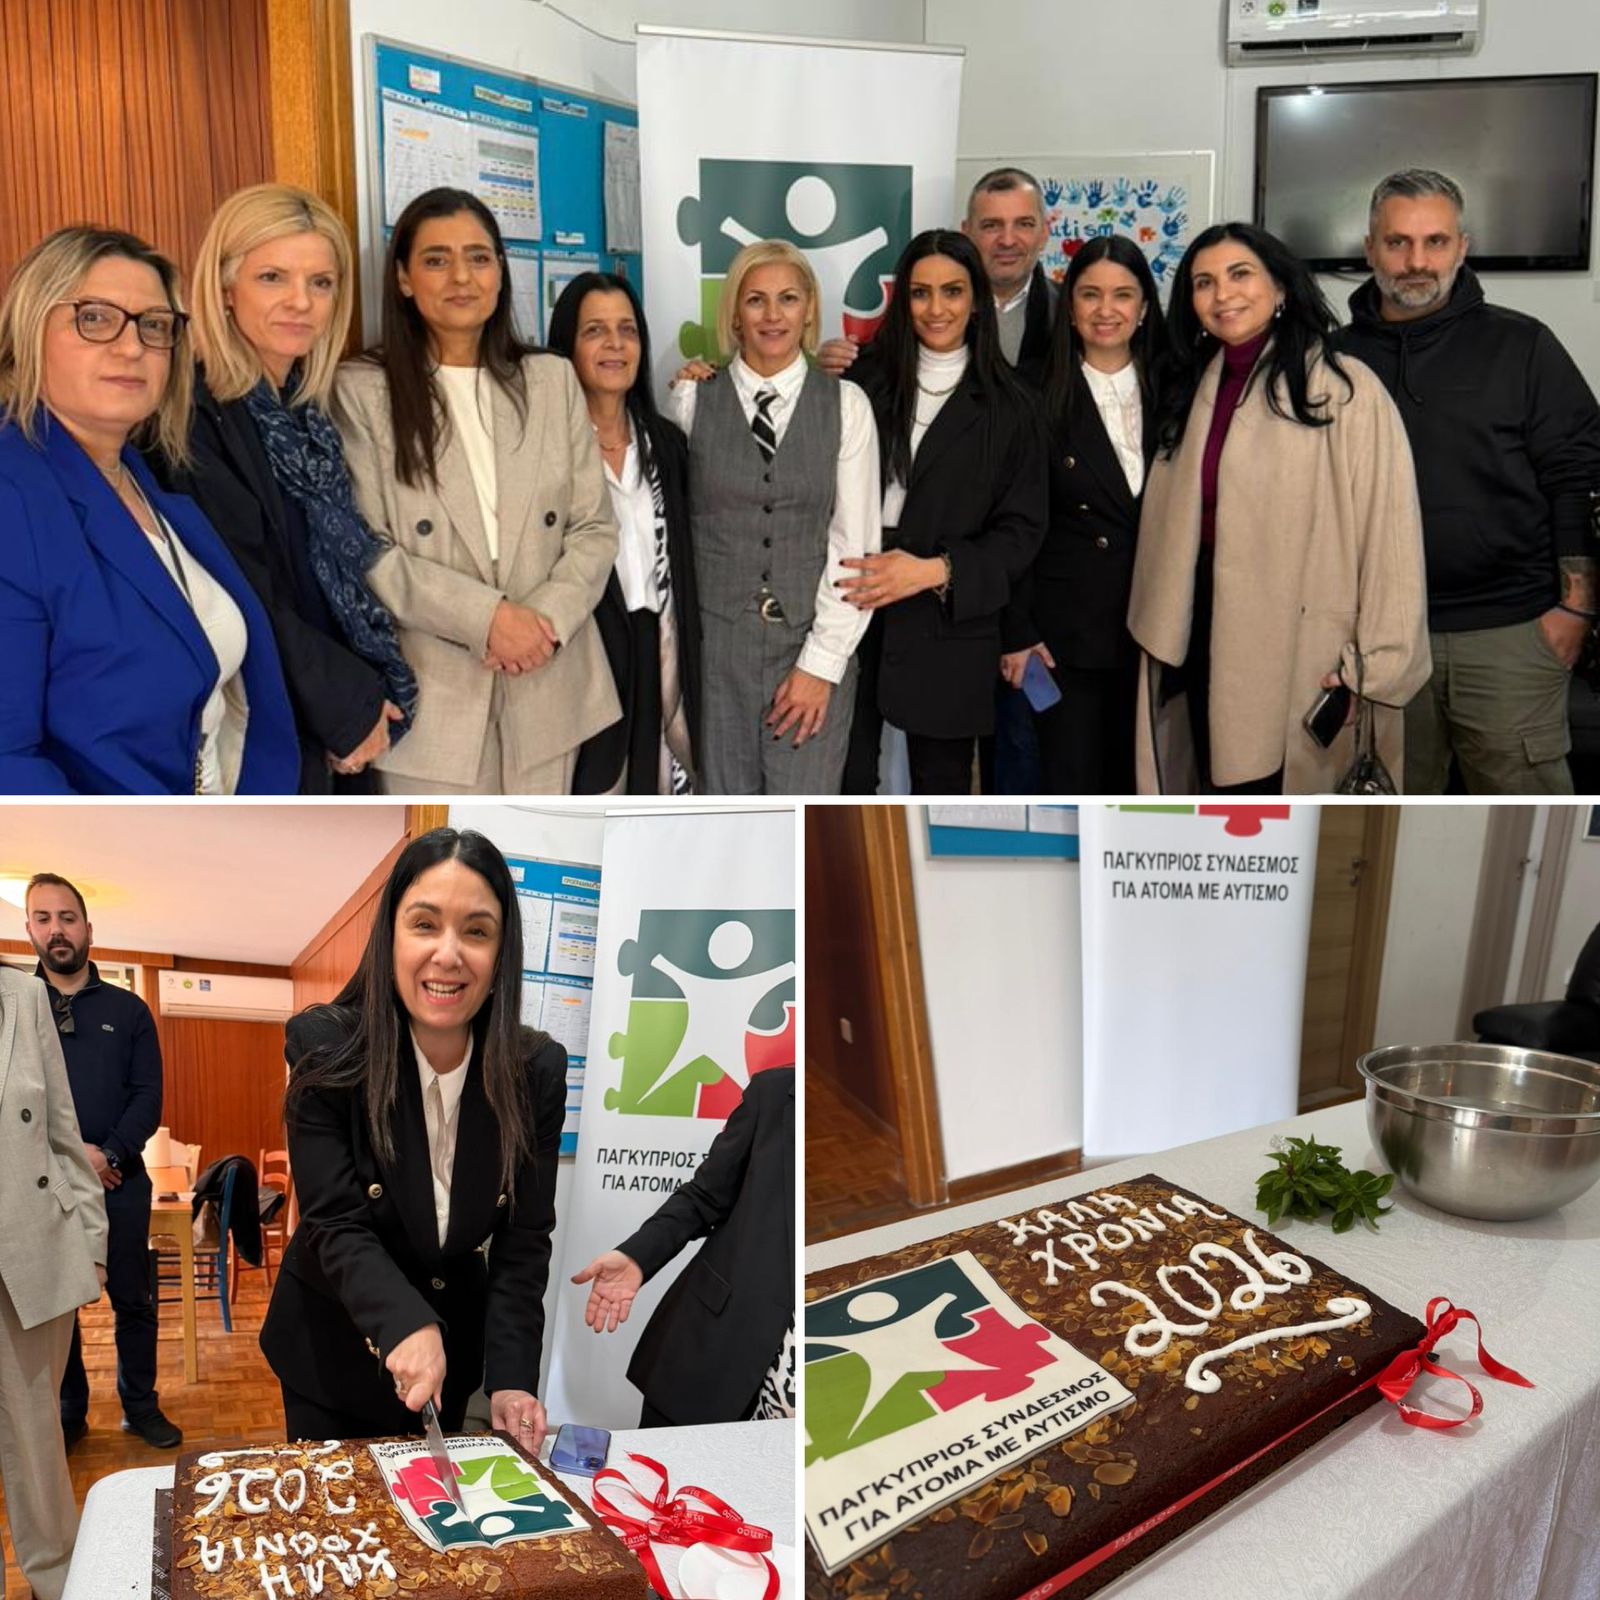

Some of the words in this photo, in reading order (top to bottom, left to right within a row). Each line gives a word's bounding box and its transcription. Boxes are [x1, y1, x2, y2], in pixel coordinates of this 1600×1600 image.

[1050, 216, 1114, 237] utism
[1103, 850, 1202, 871] ΠΑΓΚΥΠΡΙΟΣ
[1207, 854, 1299, 874] ΣΥΝΔΕΣΜΟΣ
[1112, 881, 1137, 899] ΓΙΑ
[1141, 881, 1193, 900] ΑΤΟΜΑ
[1198, 882, 1220, 900] ΜΕ
[1223, 883, 1289, 901] ΑΥΤΙΣΜΟ
[597, 1148, 696, 1168] ΠΑΓΚΥΠΡΙΟΣ
[602, 1174, 626, 1190] ΓΙΑ
[1031, 1195, 1228, 1285] ΧΡΟΝΙΑ
[1089, 1228, 1312, 1357] 2026
[818, 1434, 981, 1526] ΠΑΓΚΥΠΡΙΟΣ
[981, 1371, 1108, 1440] ΣΥΝΔΕΣΜΟΣ
[844, 1508, 891, 1541] ΓΙΑ
[896, 1458, 984, 1513] ΑΤΟΜΑ
[985, 1436, 1022, 1462] ΜΕ
[1024, 1389, 1111, 1443] ΑΥΤΙΣΜΟ
[194, 1459, 357, 1519] 2026
